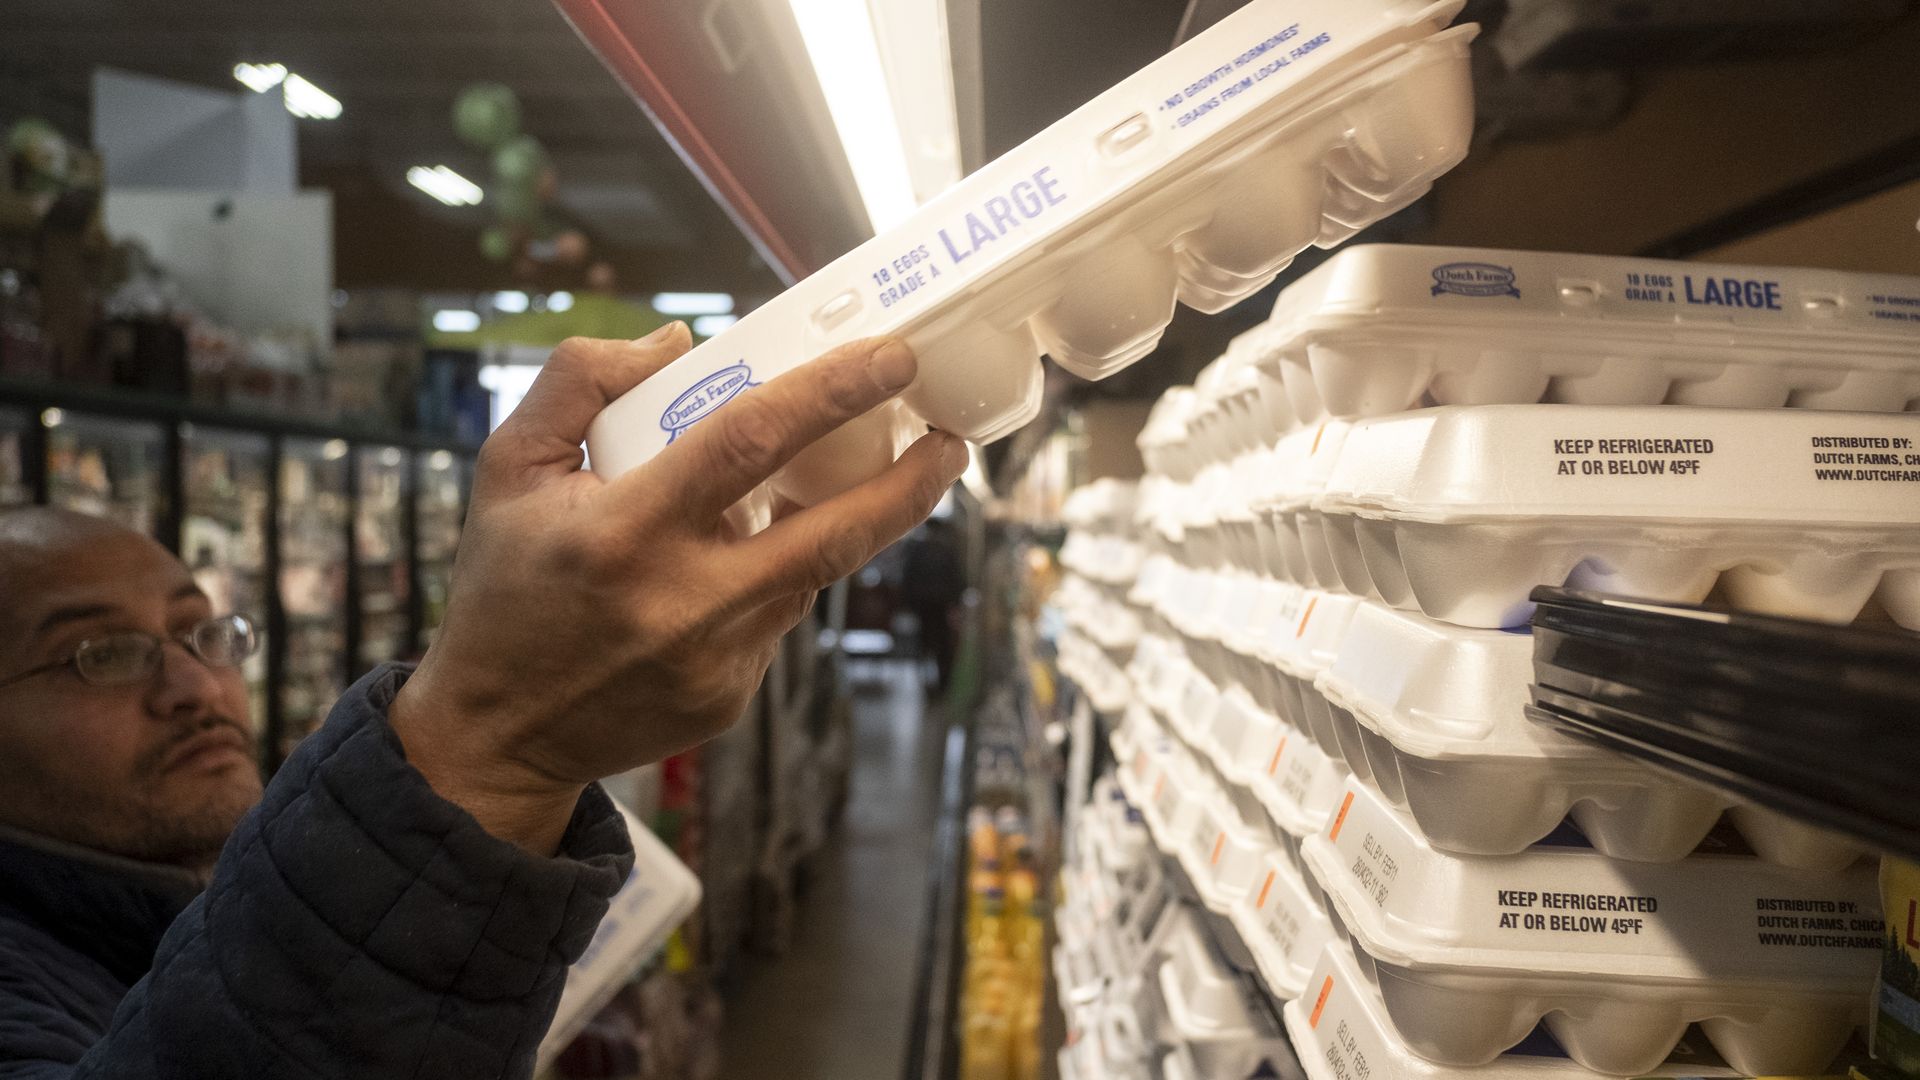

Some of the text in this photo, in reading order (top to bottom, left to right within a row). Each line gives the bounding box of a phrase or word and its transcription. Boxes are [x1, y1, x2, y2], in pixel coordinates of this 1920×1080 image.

[1166, 93, 1183, 109] NO
[1184, 64, 1233, 98] GROWTH
[1177, 32, 1331, 127] GRAINS FROM LOCAL FARMS
[938, 166, 1067, 264] LARGE
[872, 244, 931, 287] 18 EGGS
[879, 263, 941, 308] GRADE A
[1645, 274, 1673, 288] EGGS
[1625, 288, 1676, 303] GRADE A
[1684, 275, 1782, 311] LARGE
[667, 373, 745, 427] Dutch Farms
[1554, 438, 1714, 454] KEEP REFRIGERATED
[1812, 437, 1912, 449] DISTRIBUTED BY:
[1557, 460, 1577, 475] AT
[1581, 460, 1604, 475] OR
[1608, 460, 1665, 475] BELOW
[1814, 453, 1854, 464] DUTCH
[1857, 454, 1902, 466] FARMS,
[1363, 832, 1398, 882] SELL BY FEB11
[1498, 890, 1658, 913] KEEP REFRIGERATED
[1757, 898, 1858, 914] DISTRIBUTED BY:
[1499, 912, 1520, 928] AT
[1524, 914, 1545, 930] OR
[1550, 915, 1607, 933] BELOW
[1758, 916, 1799, 928] DUTCH
[1802, 918, 1848, 932] FARMS,
[1337, 1019, 1350, 1047] SELL
[1346, 1037, 1357, 1056] BY
